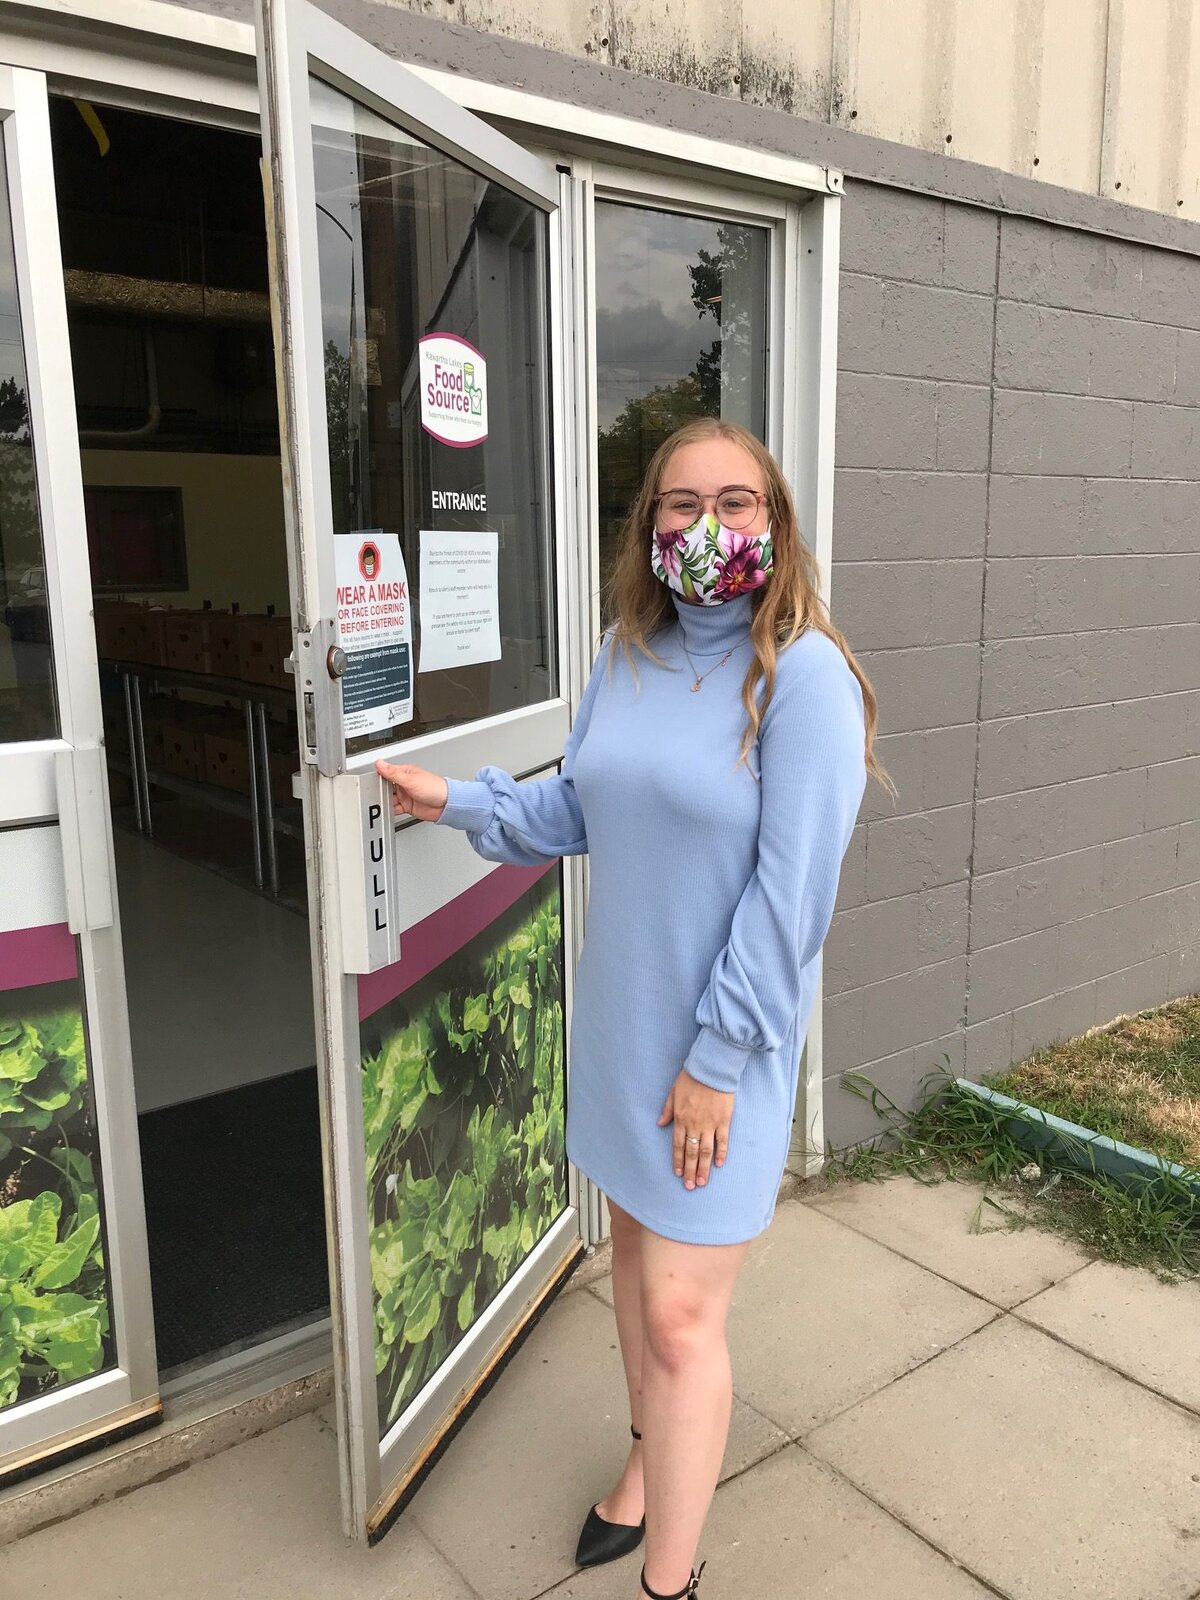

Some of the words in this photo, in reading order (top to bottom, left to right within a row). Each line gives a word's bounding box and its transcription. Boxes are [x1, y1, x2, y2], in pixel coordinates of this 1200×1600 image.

[426, 351, 448, 364] Kawartha
[449, 357, 462, 368] Lakes
[435, 364, 463, 392] Food
[428, 383, 469, 412] Source
[432, 490, 487, 511] ENTRANCE
[369, 585, 376, 602] A
[378, 582, 406, 601] MASK
[338, 609, 350, 620] OR
[352, 606, 369, 618] FACE
[370, 602, 405, 615] COVERING
[341, 620, 369, 634] BEFORE
[371, 615, 404, 629] ENTERING
[369, 804, 387, 931] PULL
